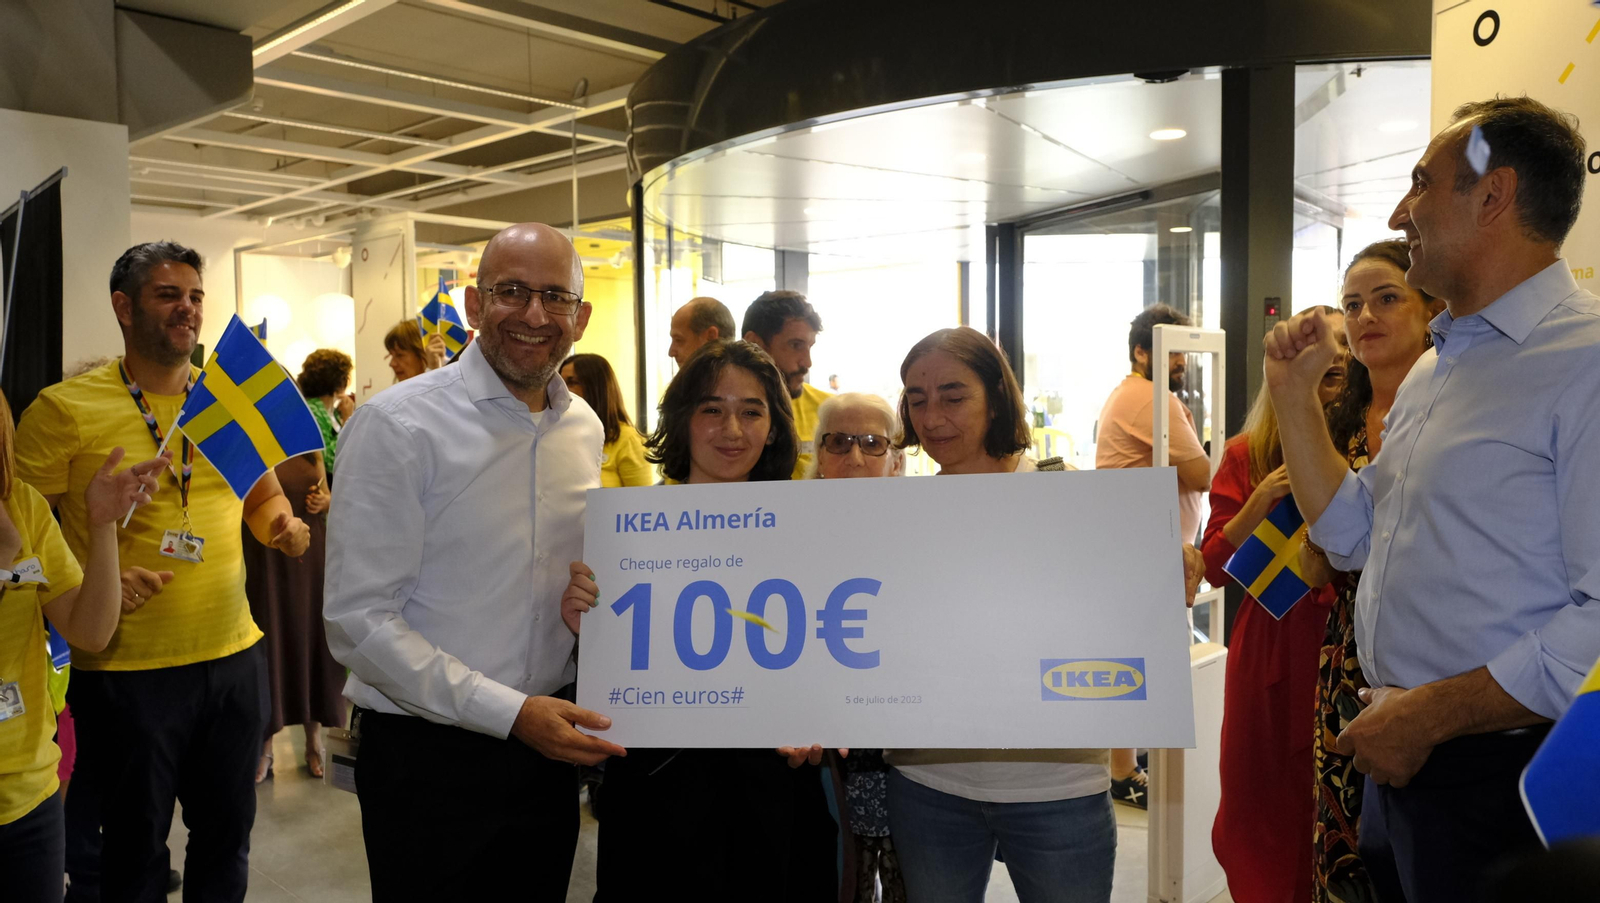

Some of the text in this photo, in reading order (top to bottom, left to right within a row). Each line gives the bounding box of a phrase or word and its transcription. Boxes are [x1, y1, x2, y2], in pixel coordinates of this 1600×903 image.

[615, 507, 776, 533] IKEA Almería
[619, 555, 743, 573] Cheque regalo de
[609, 577, 882, 671] 100€
[1051, 671, 1137, 687] IKEA
[608, 686, 745, 705] #Cien euros#
[845, 695, 922, 707] 5 de julio de 2023
